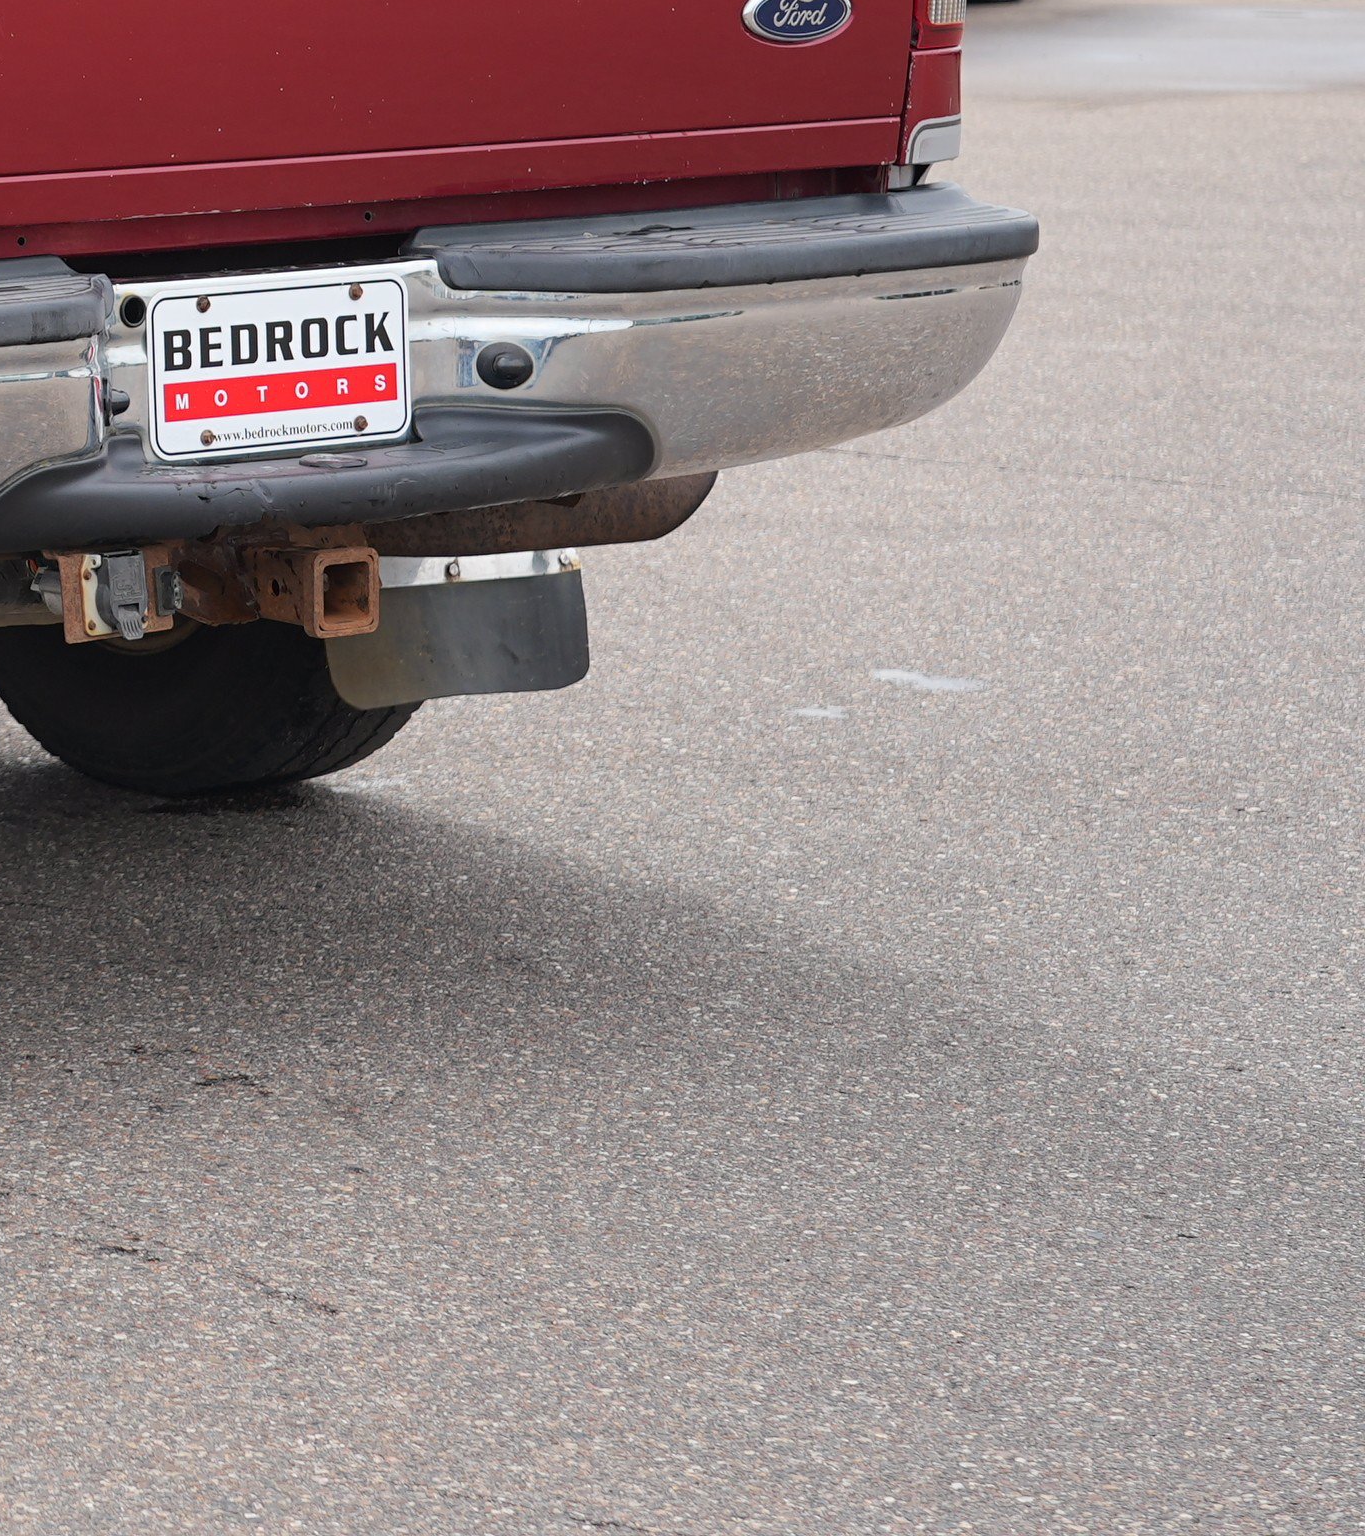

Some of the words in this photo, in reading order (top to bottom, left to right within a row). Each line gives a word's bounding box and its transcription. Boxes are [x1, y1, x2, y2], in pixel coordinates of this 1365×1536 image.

[163, 311, 395, 372] BEDROCK
[174, 374, 387, 411] MOTORS
[212, 420, 354, 442] www.bedrockmotors.com
